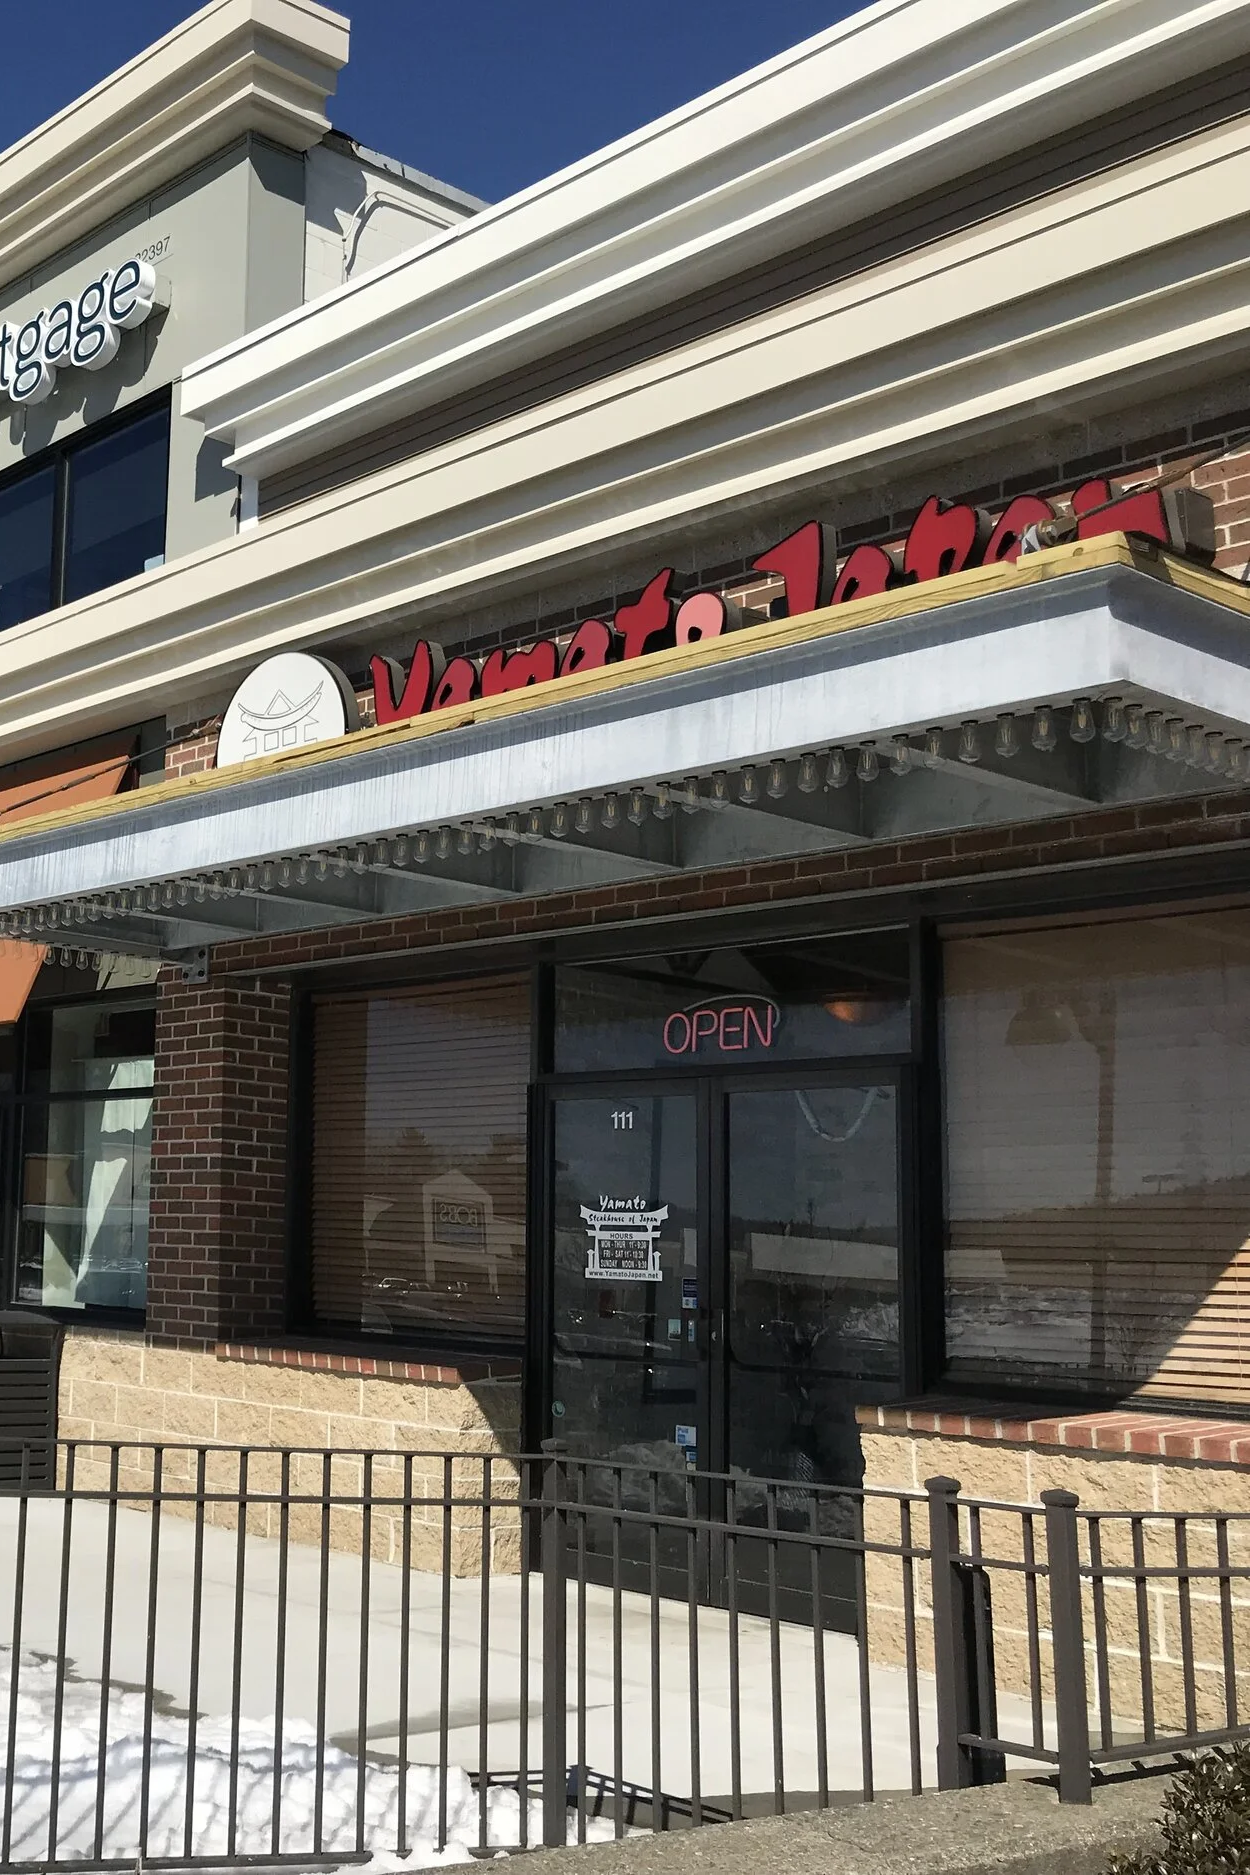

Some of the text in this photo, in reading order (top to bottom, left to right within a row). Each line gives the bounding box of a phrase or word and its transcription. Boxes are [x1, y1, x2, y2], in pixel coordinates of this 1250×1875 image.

[663, 1005, 773, 1055] OPEN
[611, 1111, 633, 1130] 111
[599, 1195, 646, 1211] Yamato
[589, 1213, 658, 1224] Steakhouse of Japan
[600, 1259, 618, 1267] SUNDAY
[589, 1270, 659, 1279] www.YamatoJapan.net
